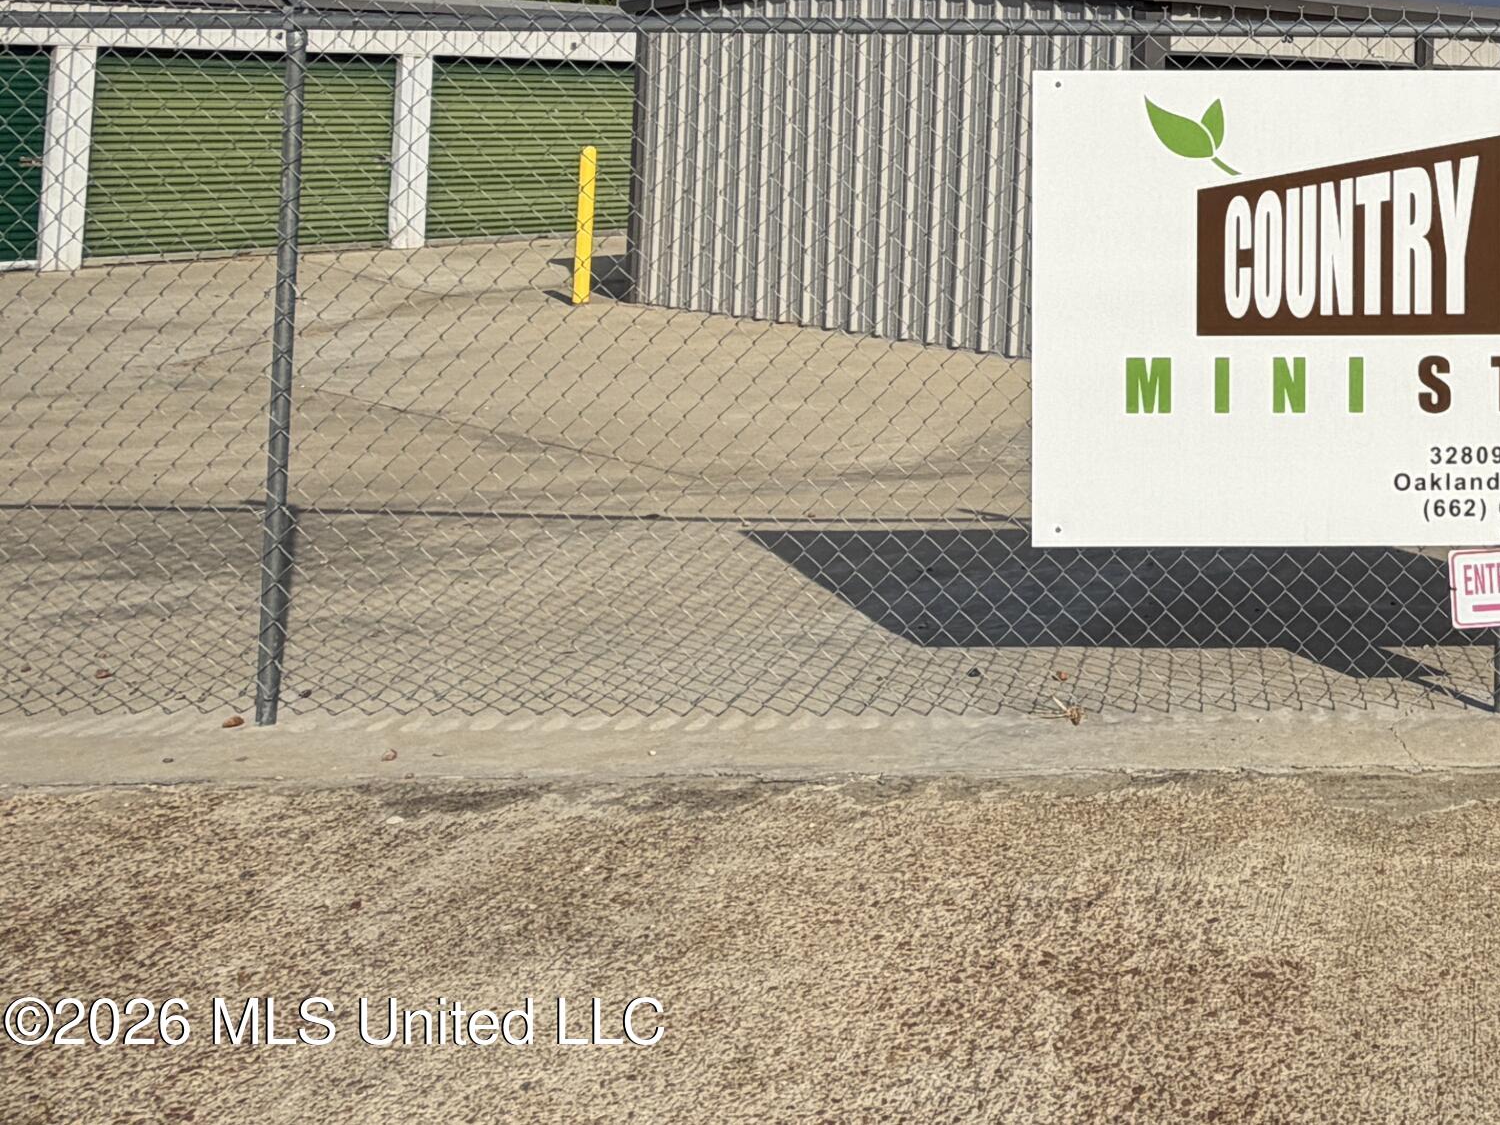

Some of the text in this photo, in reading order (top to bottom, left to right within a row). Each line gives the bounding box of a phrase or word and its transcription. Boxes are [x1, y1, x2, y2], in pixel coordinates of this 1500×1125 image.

[1224, 155, 1480, 319] COUNTRY
[1126, 357, 1364, 414] MINI
[1423, 499, 1488, 522] (662)
